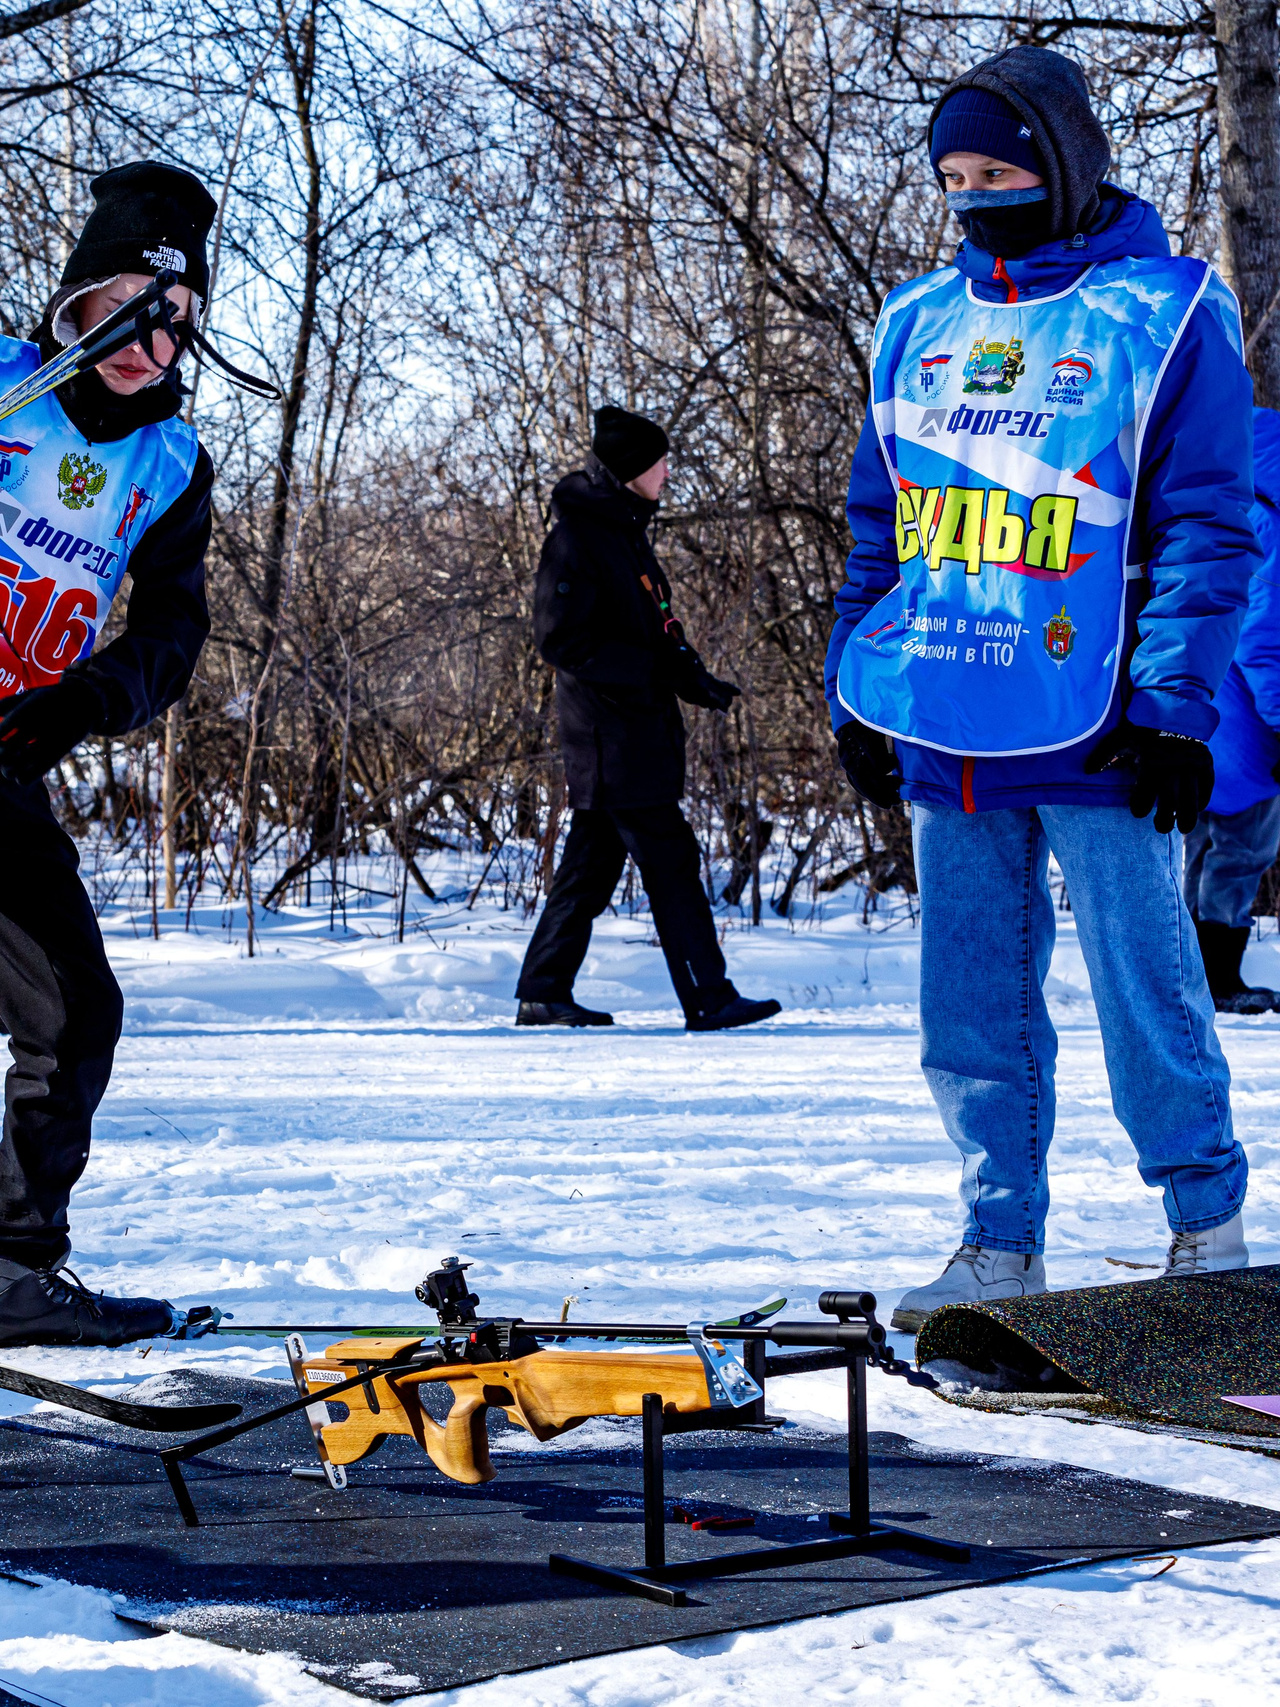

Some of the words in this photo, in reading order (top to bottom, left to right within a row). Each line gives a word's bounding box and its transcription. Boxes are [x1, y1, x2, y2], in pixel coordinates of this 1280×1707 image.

[142, 250, 173, 262] NORTH
[158, 245, 175, 255] THE
[150, 259, 172, 269] FACE
[1045, 396, 1084, 406] РОССИЯ
[1046, 388, 1084, 397] ЕДИНАЯ
[947, 403, 1055, 438] ФОРЭС
[895, 485, 1079, 575] СУДЬЯ
[16, 516, 119, 579] ФОРЭС
[956, 619, 967, 634] в
[974, 620, 1031, 646] школу-
[965, 648, 976, 663] в
[982, 642, 1014, 667] ГТО
